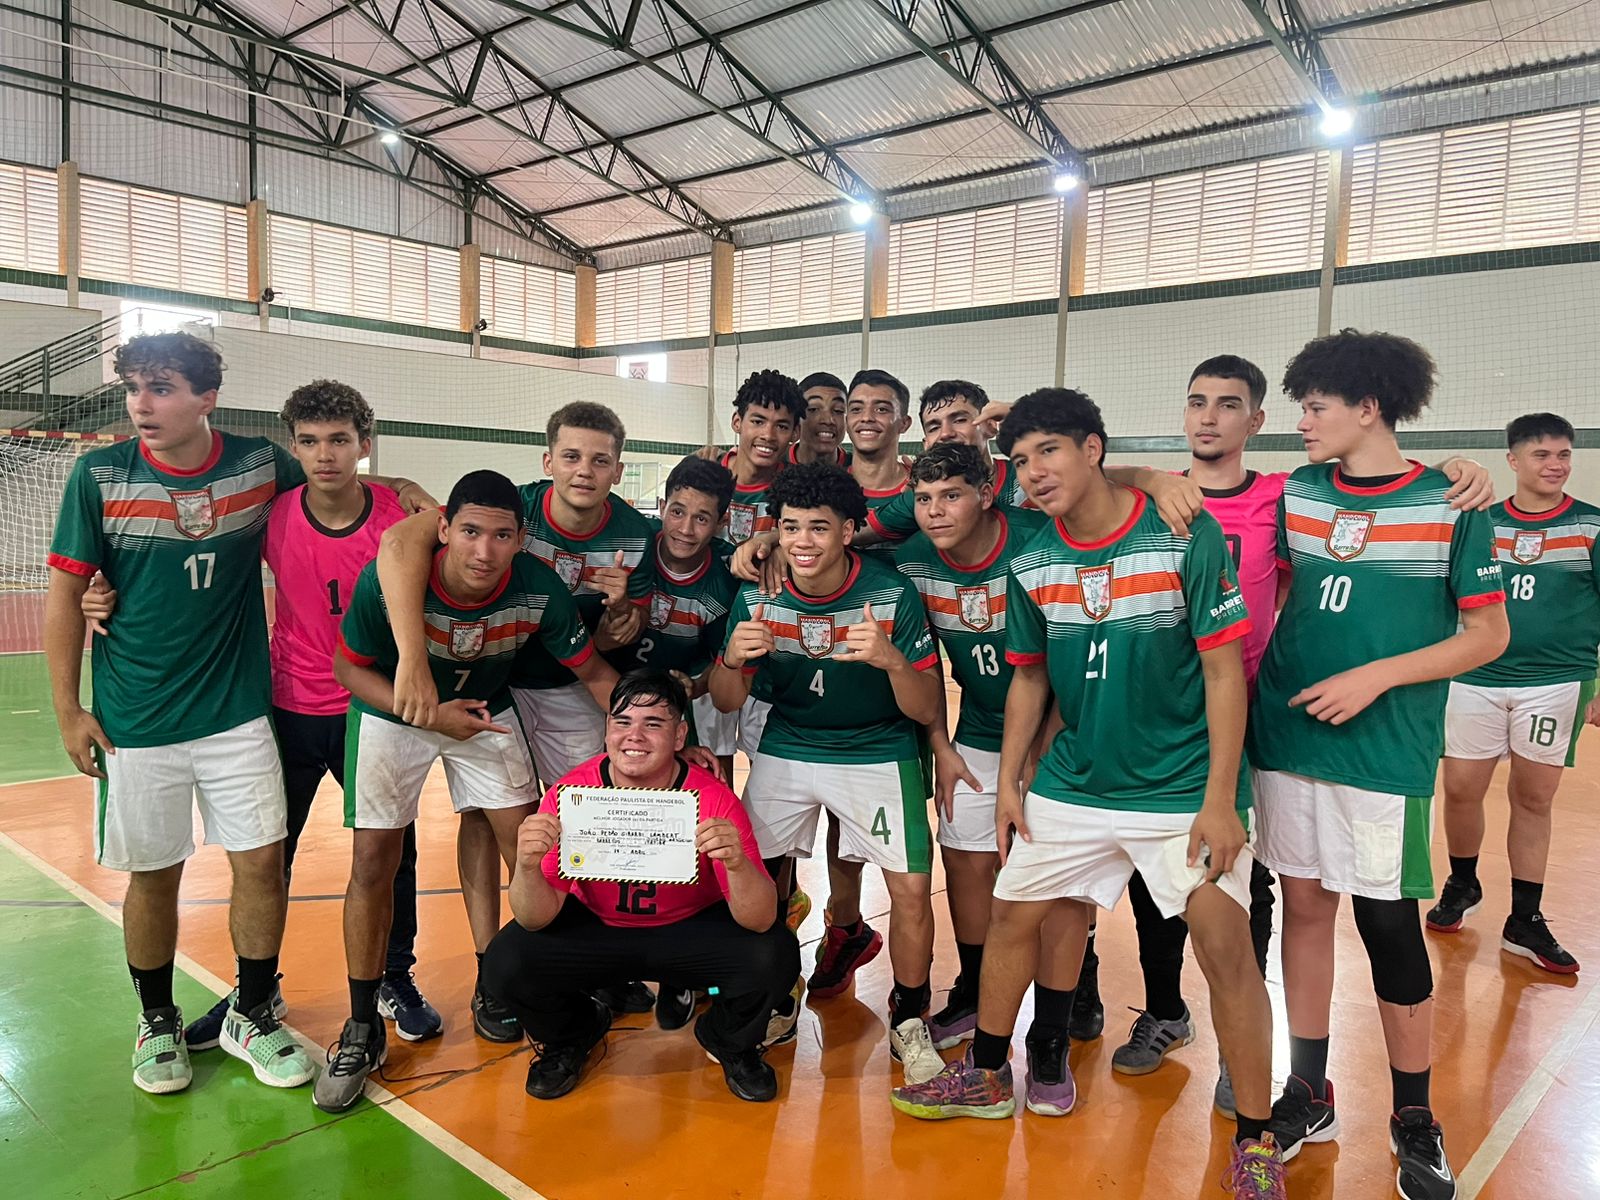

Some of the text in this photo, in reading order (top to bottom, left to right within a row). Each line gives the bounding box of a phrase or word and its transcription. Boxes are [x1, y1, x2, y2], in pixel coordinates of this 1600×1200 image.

[183, 552, 216, 590] 17
[1510, 574, 1536, 600] 18
[327, 579, 343, 615] 1
[1319, 574, 1352, 613] 10
[636, 637, 655, 663] 2
[971, 644, 1000, 677] 13
[1085, 638, 1108, 680] 21
[454, 669, 471, 692] 7
[809, 669, 825, 698] 4
[1528, 714, 1558, 747] 18
[870, 806, 891, 845] 4
[615, 880, 657, 915] 12
